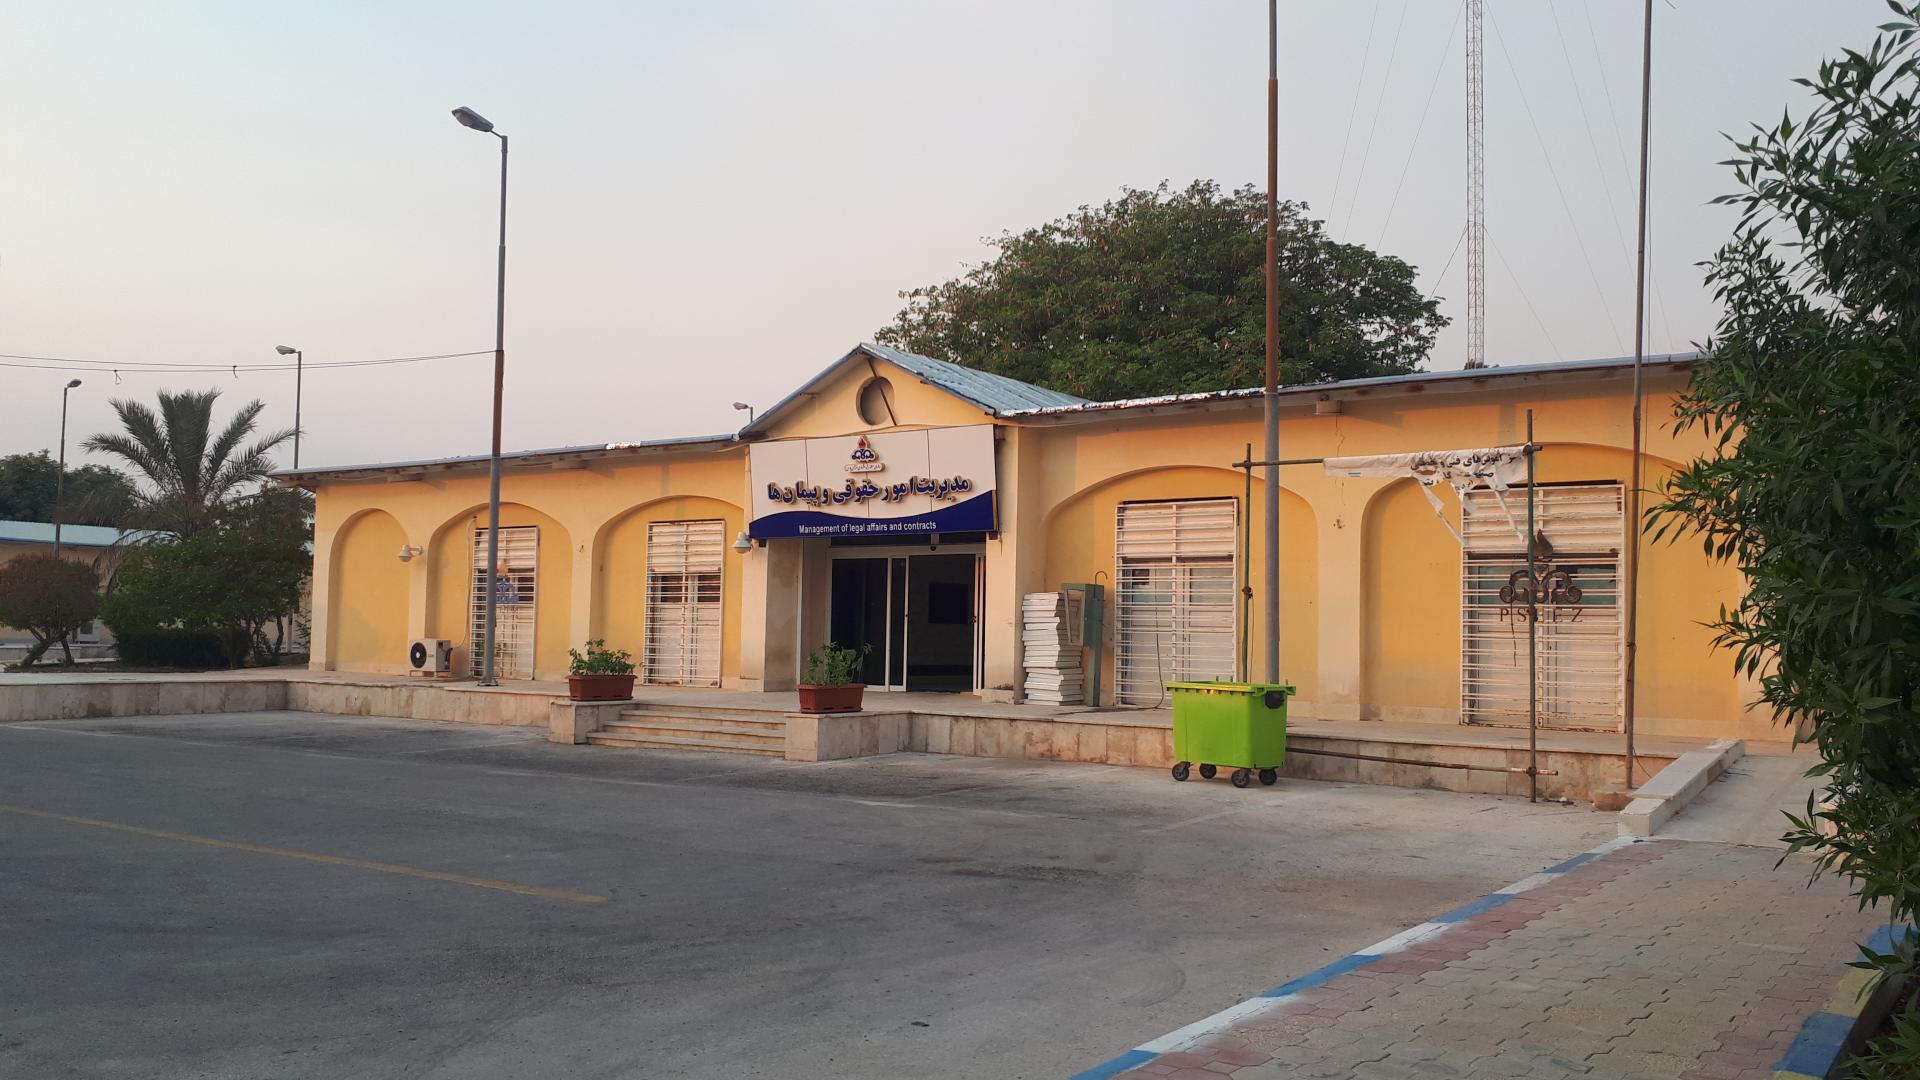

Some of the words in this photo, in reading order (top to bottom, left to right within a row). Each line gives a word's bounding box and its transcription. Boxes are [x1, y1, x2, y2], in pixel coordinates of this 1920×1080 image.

[821, 487, 831, 505] و
[832, 479, 880, 505] حقوقی
[881, 476, 916, 502] امور
[916, 476, 970, 501] مدیریت
[799, 524, 840, 535] Management
[841, 523, 849, 532] of
[849, 523, 865, 534] legal
[866, 522, 888, 532] affairs
[889, 521, 902, 531] and
[903, 521, 937, 530] contracts
